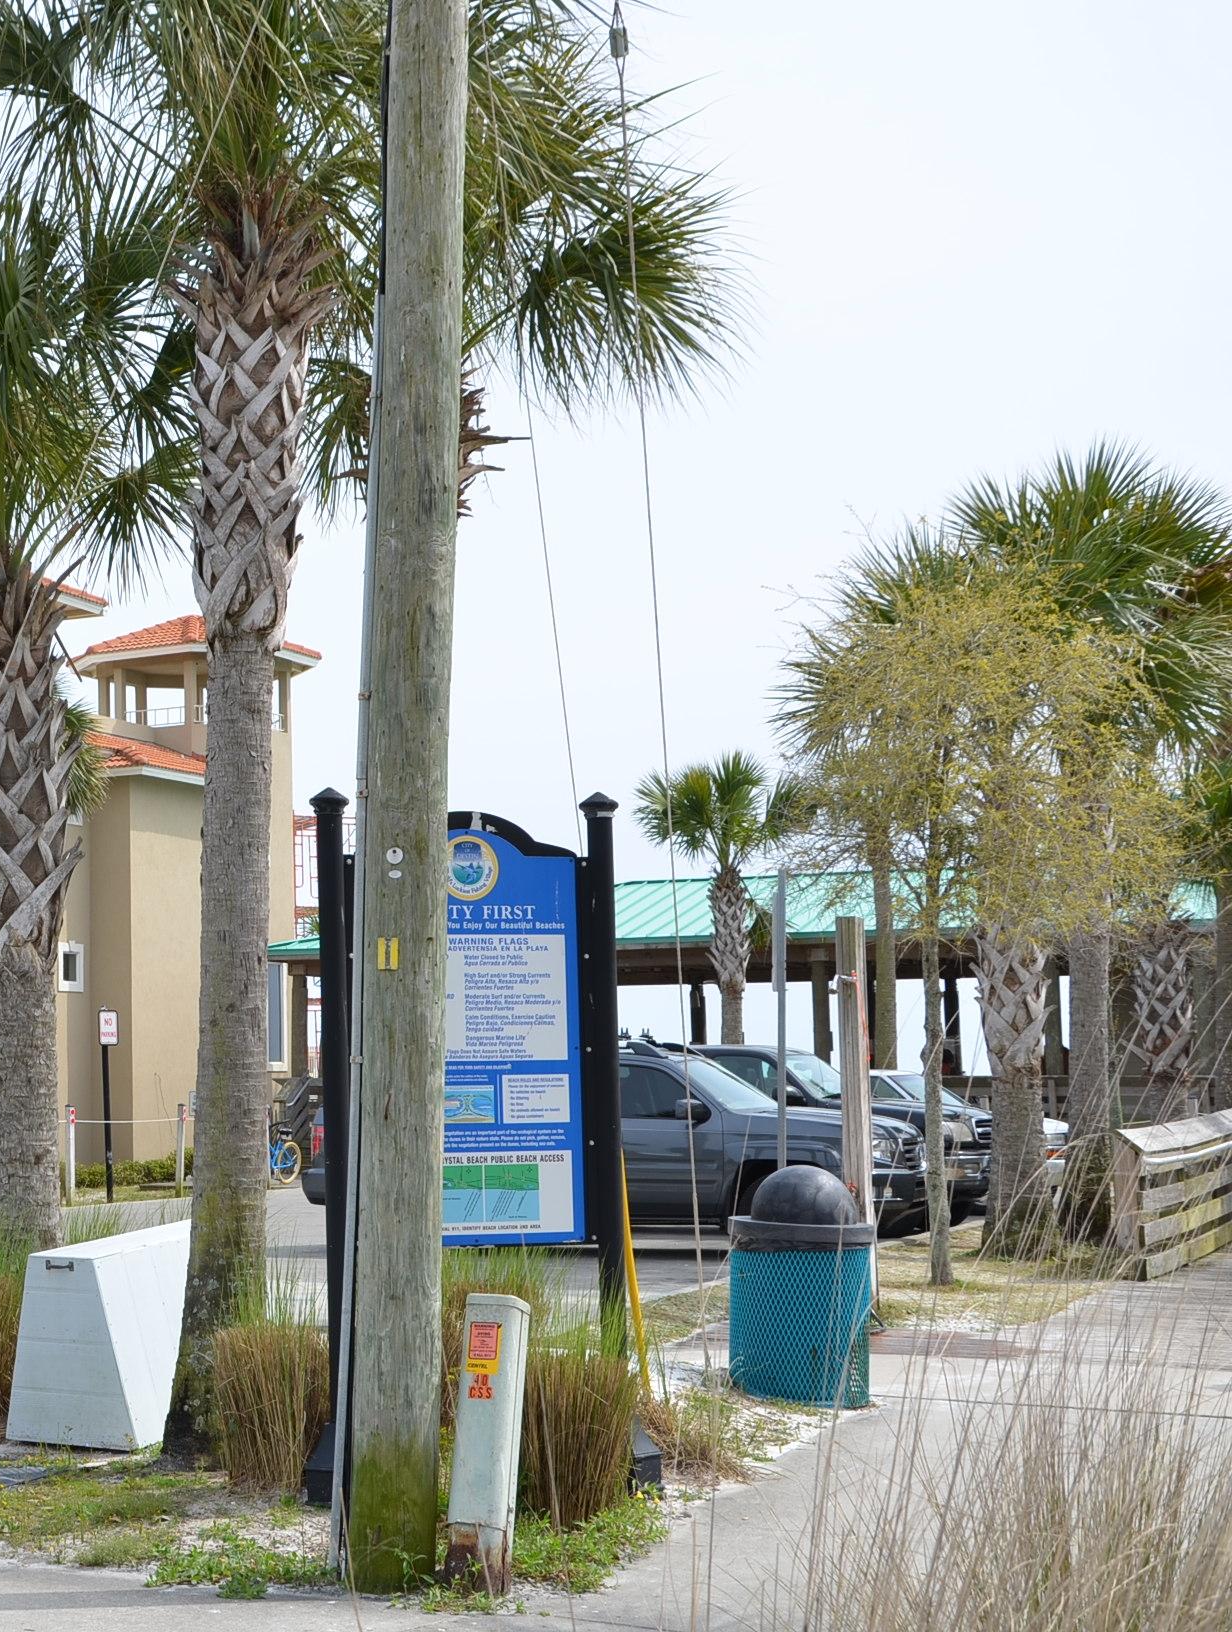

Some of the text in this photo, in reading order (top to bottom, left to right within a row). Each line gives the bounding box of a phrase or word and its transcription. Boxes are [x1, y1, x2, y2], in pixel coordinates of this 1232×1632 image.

[482, 905, 536, 919] FIRST
[447, 921, 565, 931] You Enjoy Our Beautiful Beaches
[104, 1018, 113, 1026] NO
[466, 1156, 488, 1164] BEACH
[490, 1155, 514, 1164] PUBLIC
[516, 1155, 537, 1163] BEACH
[539, 1154, 565, 1163] ACCESS
